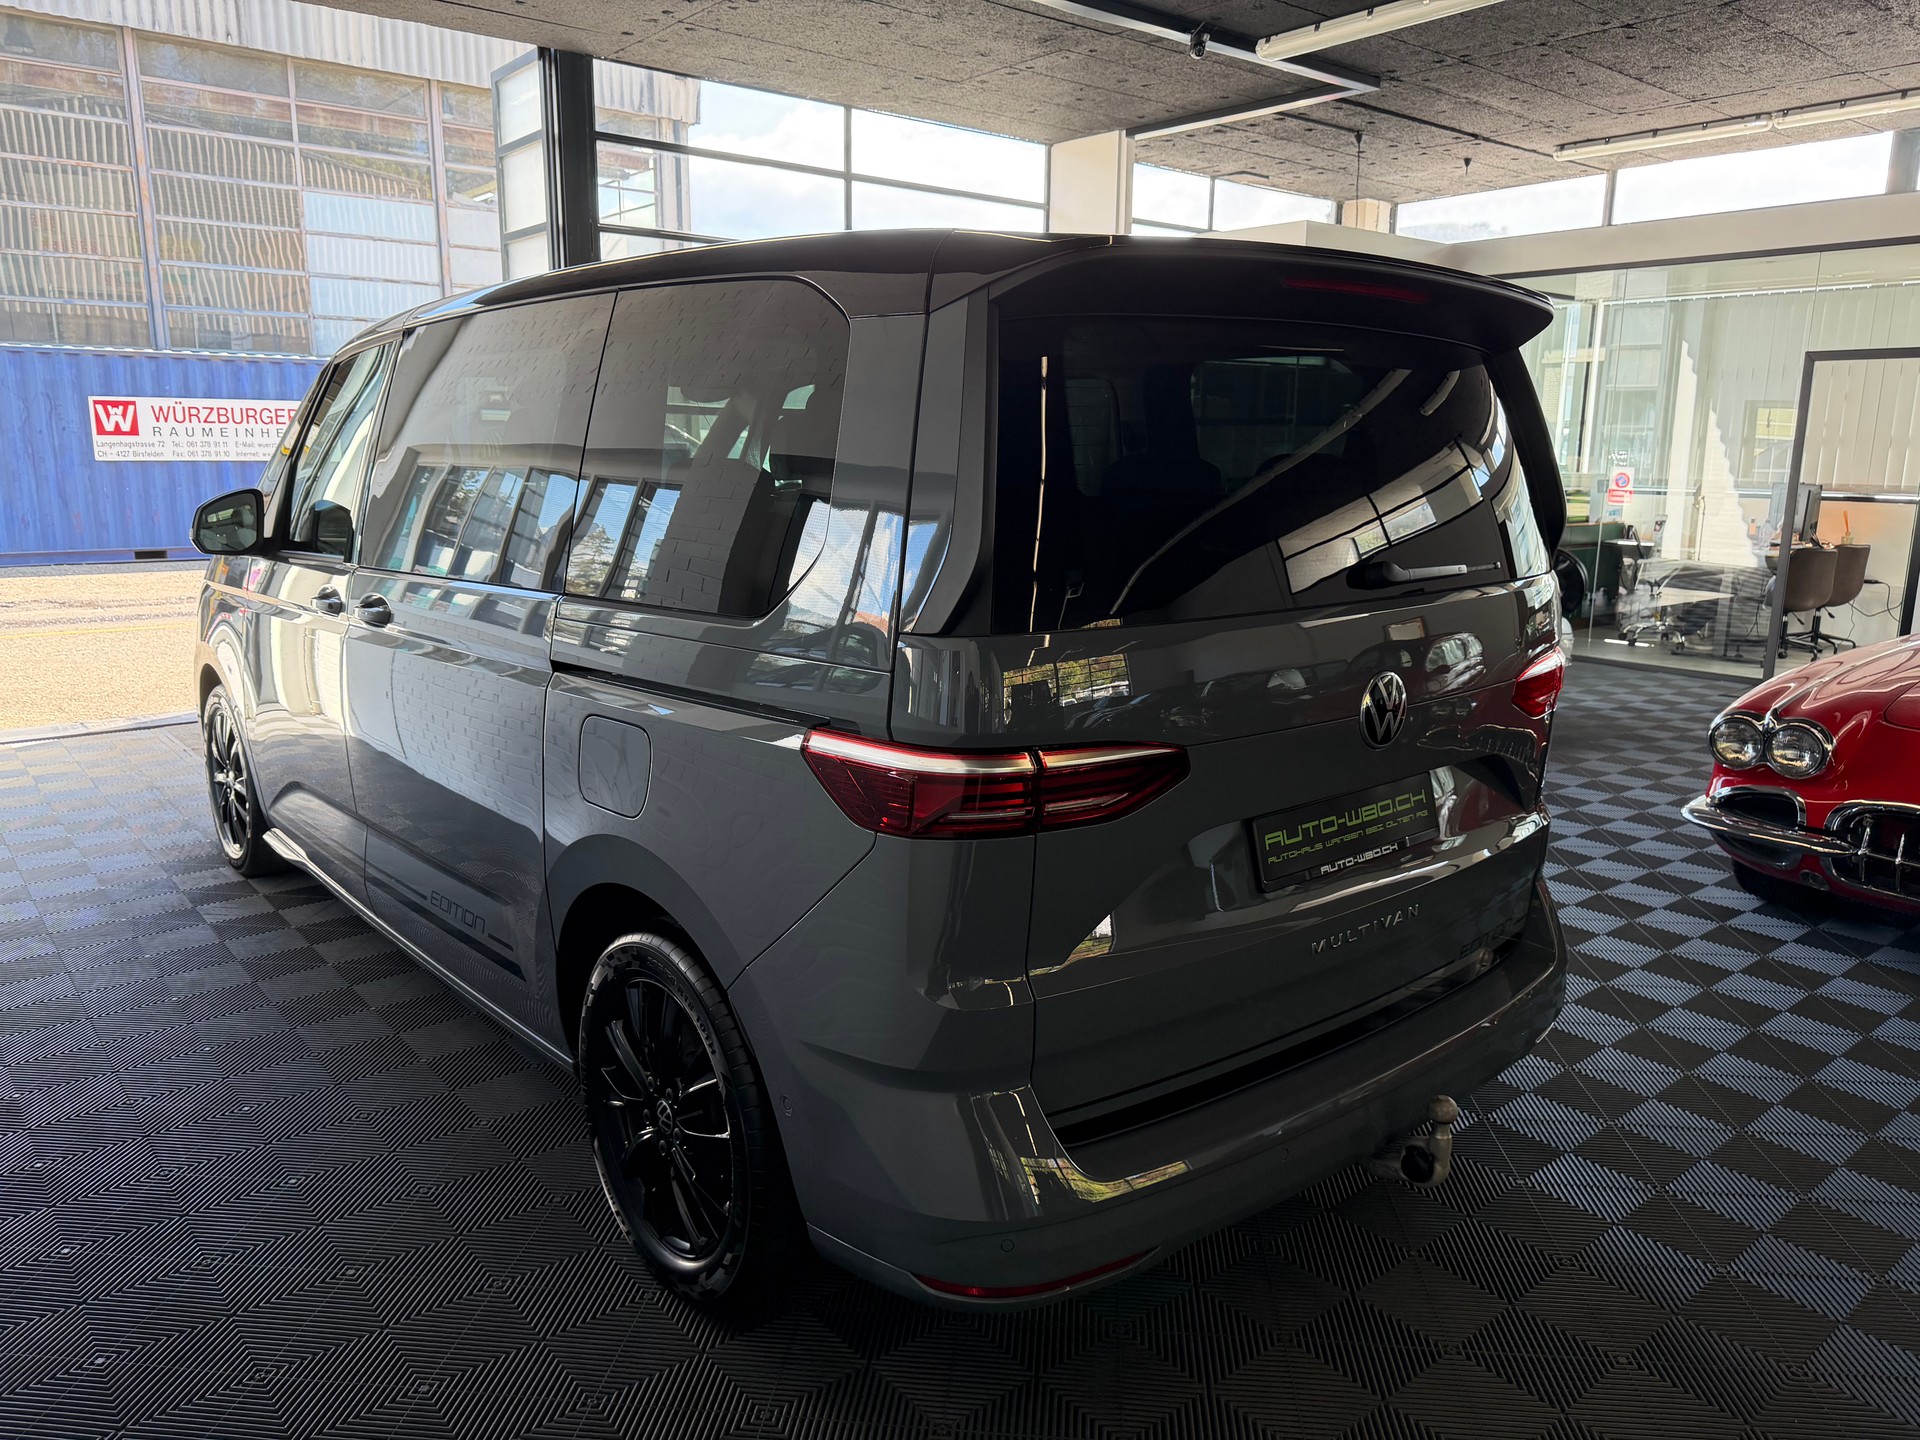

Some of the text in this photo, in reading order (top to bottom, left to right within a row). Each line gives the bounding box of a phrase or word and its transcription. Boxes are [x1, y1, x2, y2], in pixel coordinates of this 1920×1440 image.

[96, 440, 165, 449] Langenhagstrasse 72
[152, 426, 284, 438] RAUMEINHE
[1268, 809, 1429, 864] AUTOHAUS WANGEN BEI OLTEN AG
[1310, 903, 1420, 954] MULTIVAN
